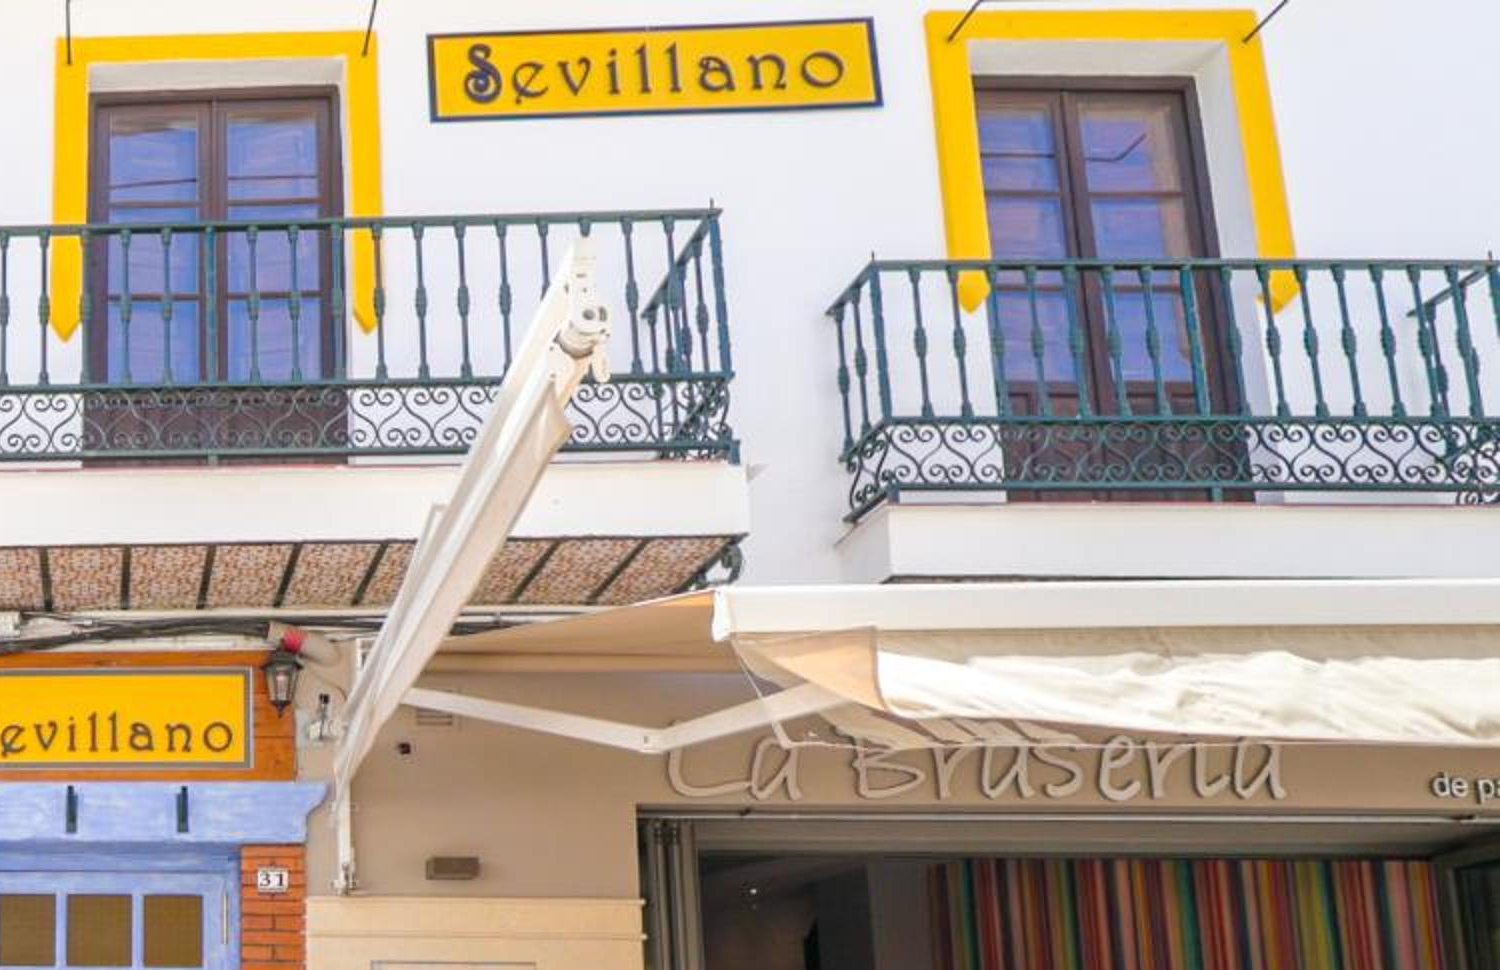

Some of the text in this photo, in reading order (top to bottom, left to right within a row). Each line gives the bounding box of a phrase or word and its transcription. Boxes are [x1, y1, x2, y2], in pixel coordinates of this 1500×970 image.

[463, 41, 845, 105] Sevillano
[1430, 771, 1468, 797] de
[259, 872, 283, 887] 31
